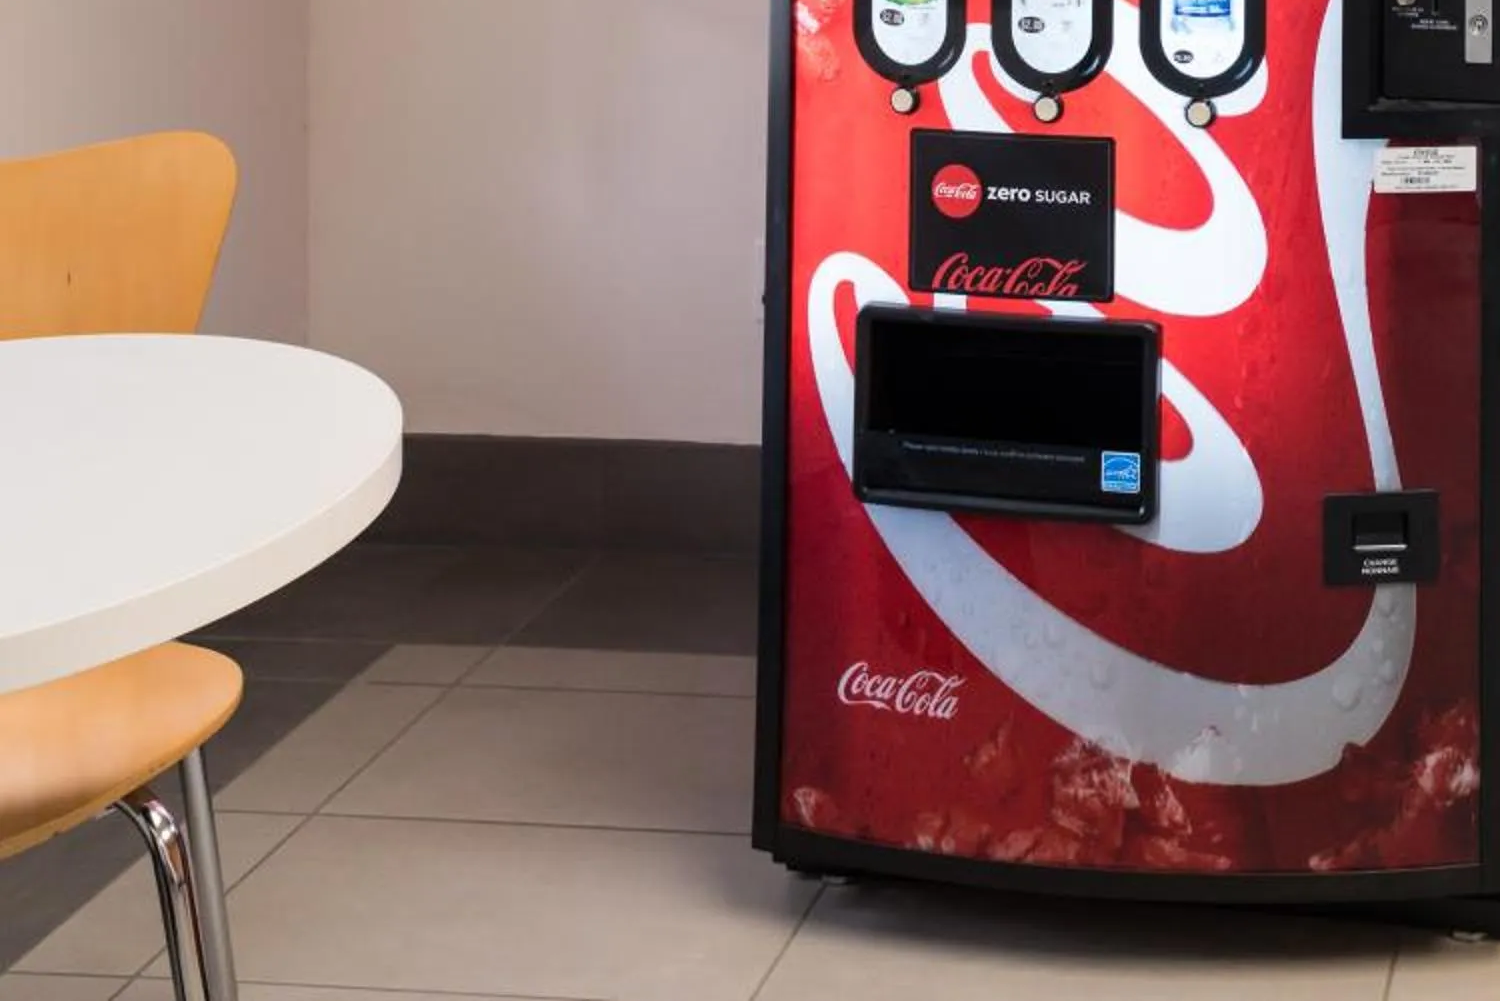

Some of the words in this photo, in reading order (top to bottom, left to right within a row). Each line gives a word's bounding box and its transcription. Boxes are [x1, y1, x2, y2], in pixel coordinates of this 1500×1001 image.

[934, 181, 979, 200] Coca-Cola
[987, 186, 1031, 202] zero
[1035, 189, 1091, 205] SUGAR
[932, 252, 1088, 297] Coca-Cola
[838, 661, 967, 719] Coca-Cola
